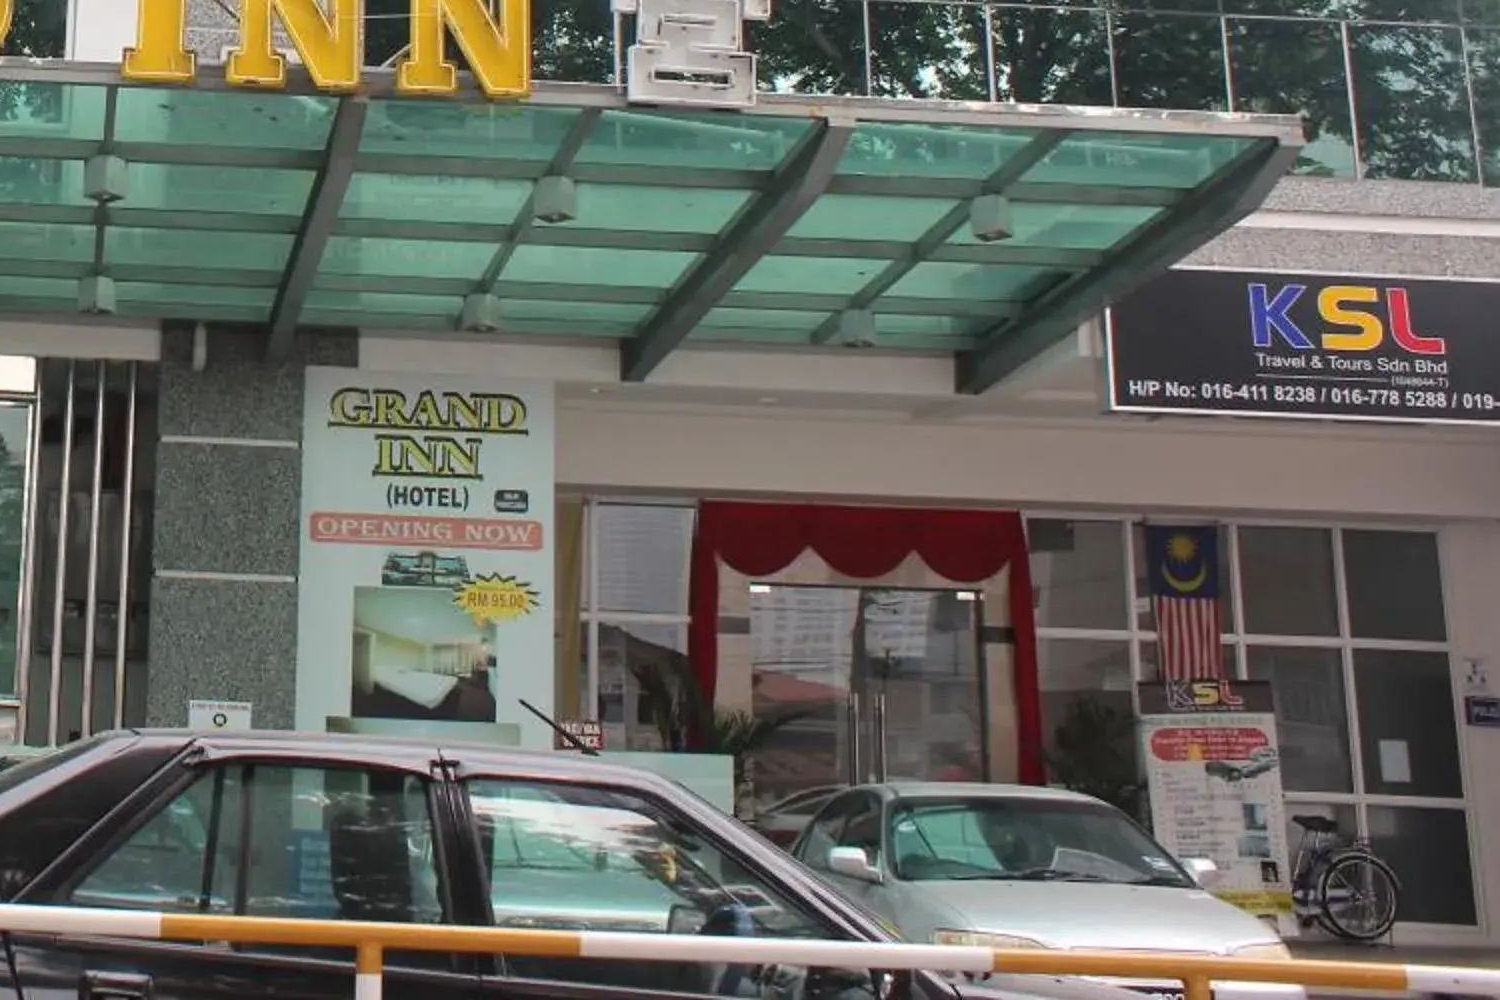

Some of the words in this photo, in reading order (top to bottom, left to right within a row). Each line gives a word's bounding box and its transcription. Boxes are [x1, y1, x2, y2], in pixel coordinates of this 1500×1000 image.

[1248, 283, 1445, 355] KSL
[1256, 352, 1306, 370] Travel
[1311, 355, 1324, 370] &
[1326, 355, 1372, 372] Tours
[1378, 357, 1410, 373] Sdn
[1415, 359, 1448, 375] Bhd
[1129, 380, 1161, 398] H/P
[1165, 383, 1197, 399] No:
[1201, 384, 1270, 402] 016-411
[1274, 386, 1316, 403] 8238
[1331, 388, 1399, 406] 016-778
[1404, 390, 1448, 408] 5288
[329, 386, 528, 434] GRAND
[373, 434, 483, 479] INN
[386, 485, 470, 511] (HOTEL)
[317, 517, 453, 541] OPENING
[464, 520, 534, 543] NOW
[1167, 680, 1244, 708] KSL
